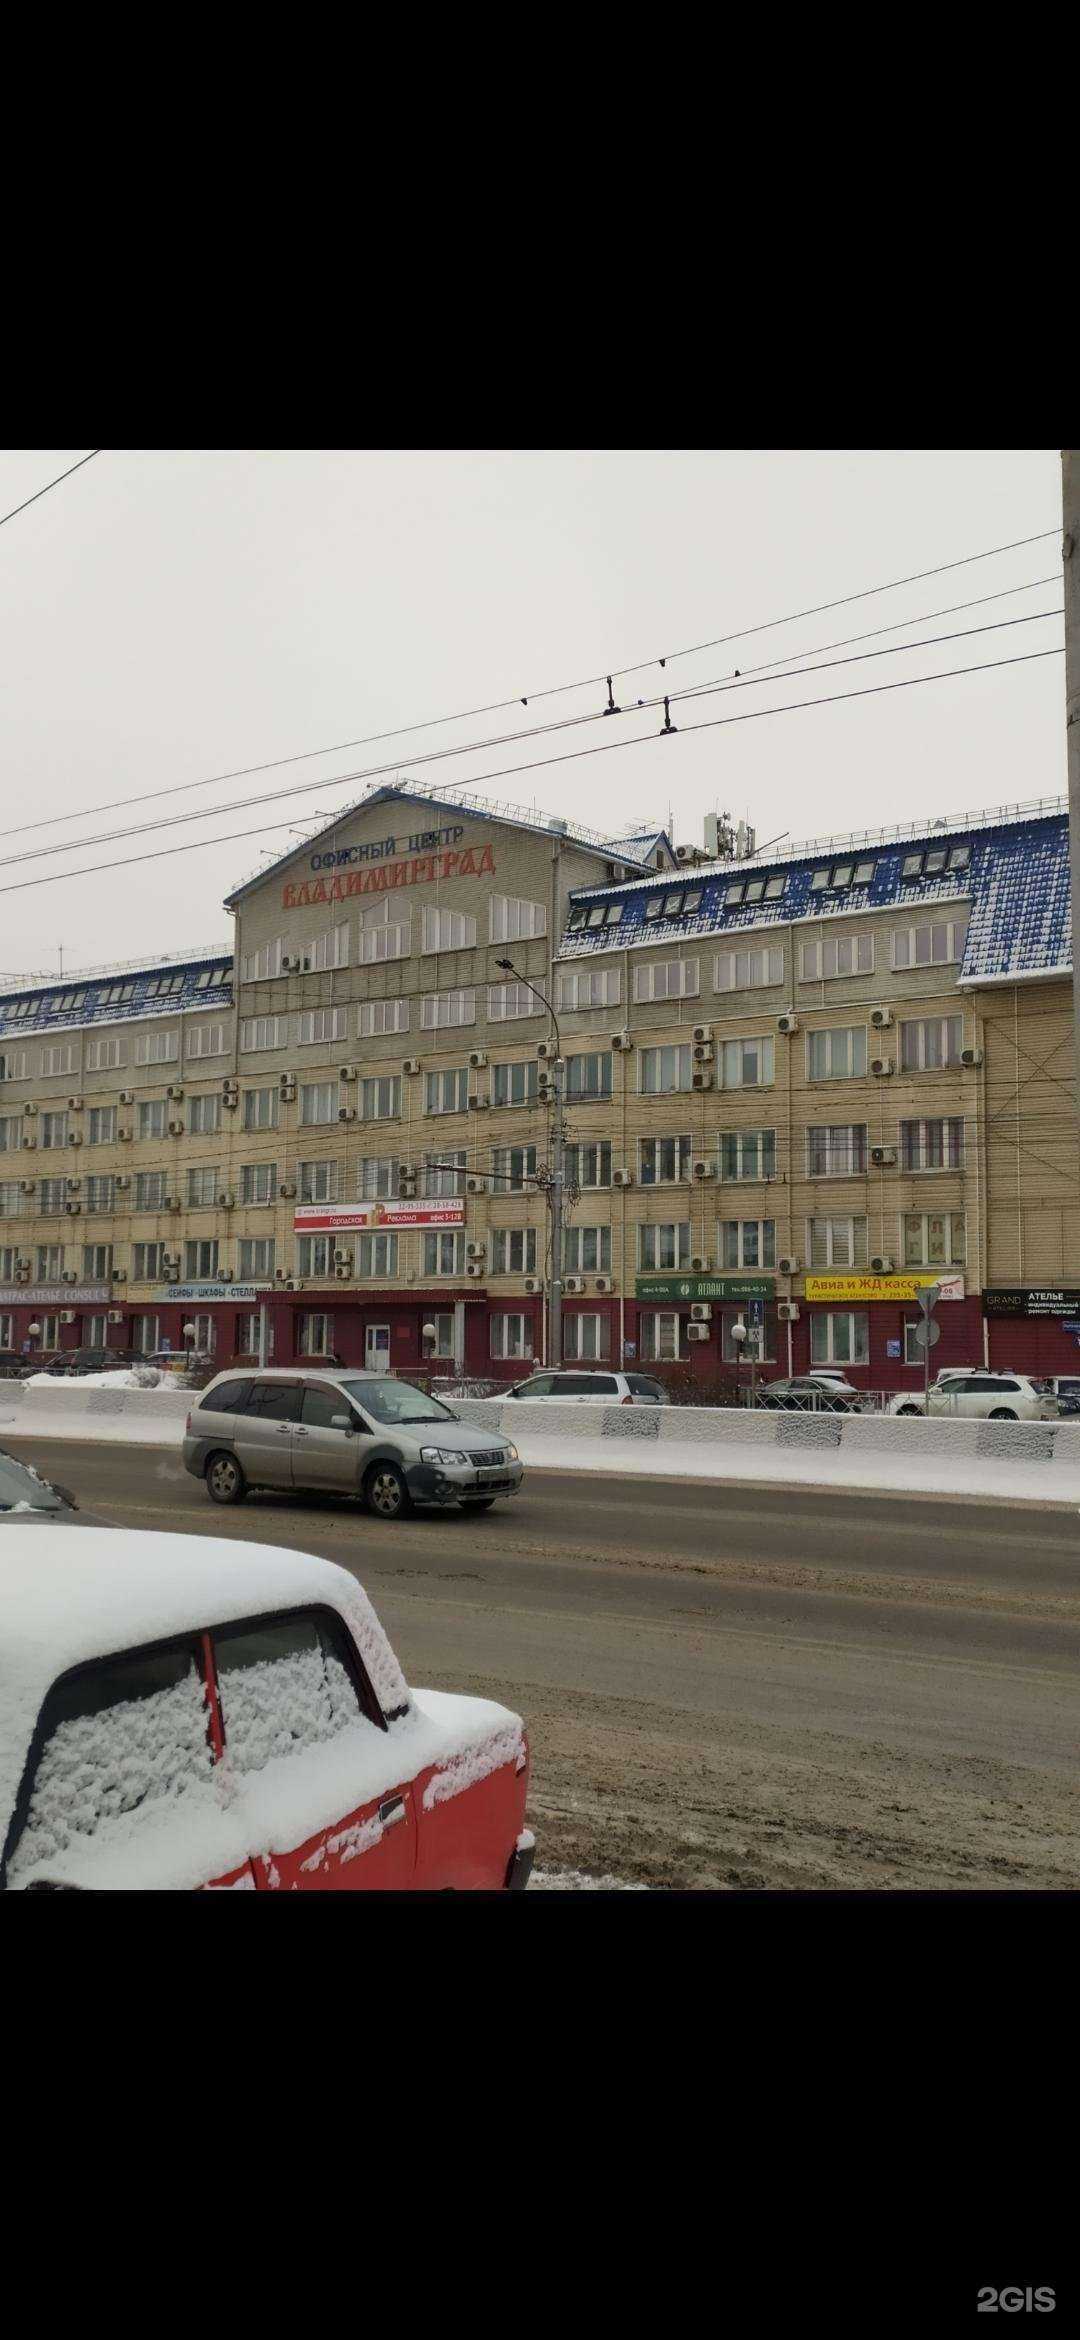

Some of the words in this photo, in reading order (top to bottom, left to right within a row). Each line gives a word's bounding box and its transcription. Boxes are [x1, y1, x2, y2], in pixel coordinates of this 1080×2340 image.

[311, 834, 396, 871] ОФИСНЫЙ
[408, 825, 464, 852] ЦЕНТР
[282, 843, 496, 908] ВЛАДИМИРГРАД
[698, 1283, 725, 1295] АТЛАНТ
[811, 1280, 844, 1290] Авиа
[859, 1279, 882, 1290] ЖД
[885, 1279, 921, 1289] касса
[168, 1288, 193, 1298] СЕЙФЫ
[198, 1287, 226, 1298] ШКАФЫ
[1028, 1292, 1064, 1301] АТЕЛЬЕ
[987, 1296, 1021, 1305] GRAND
